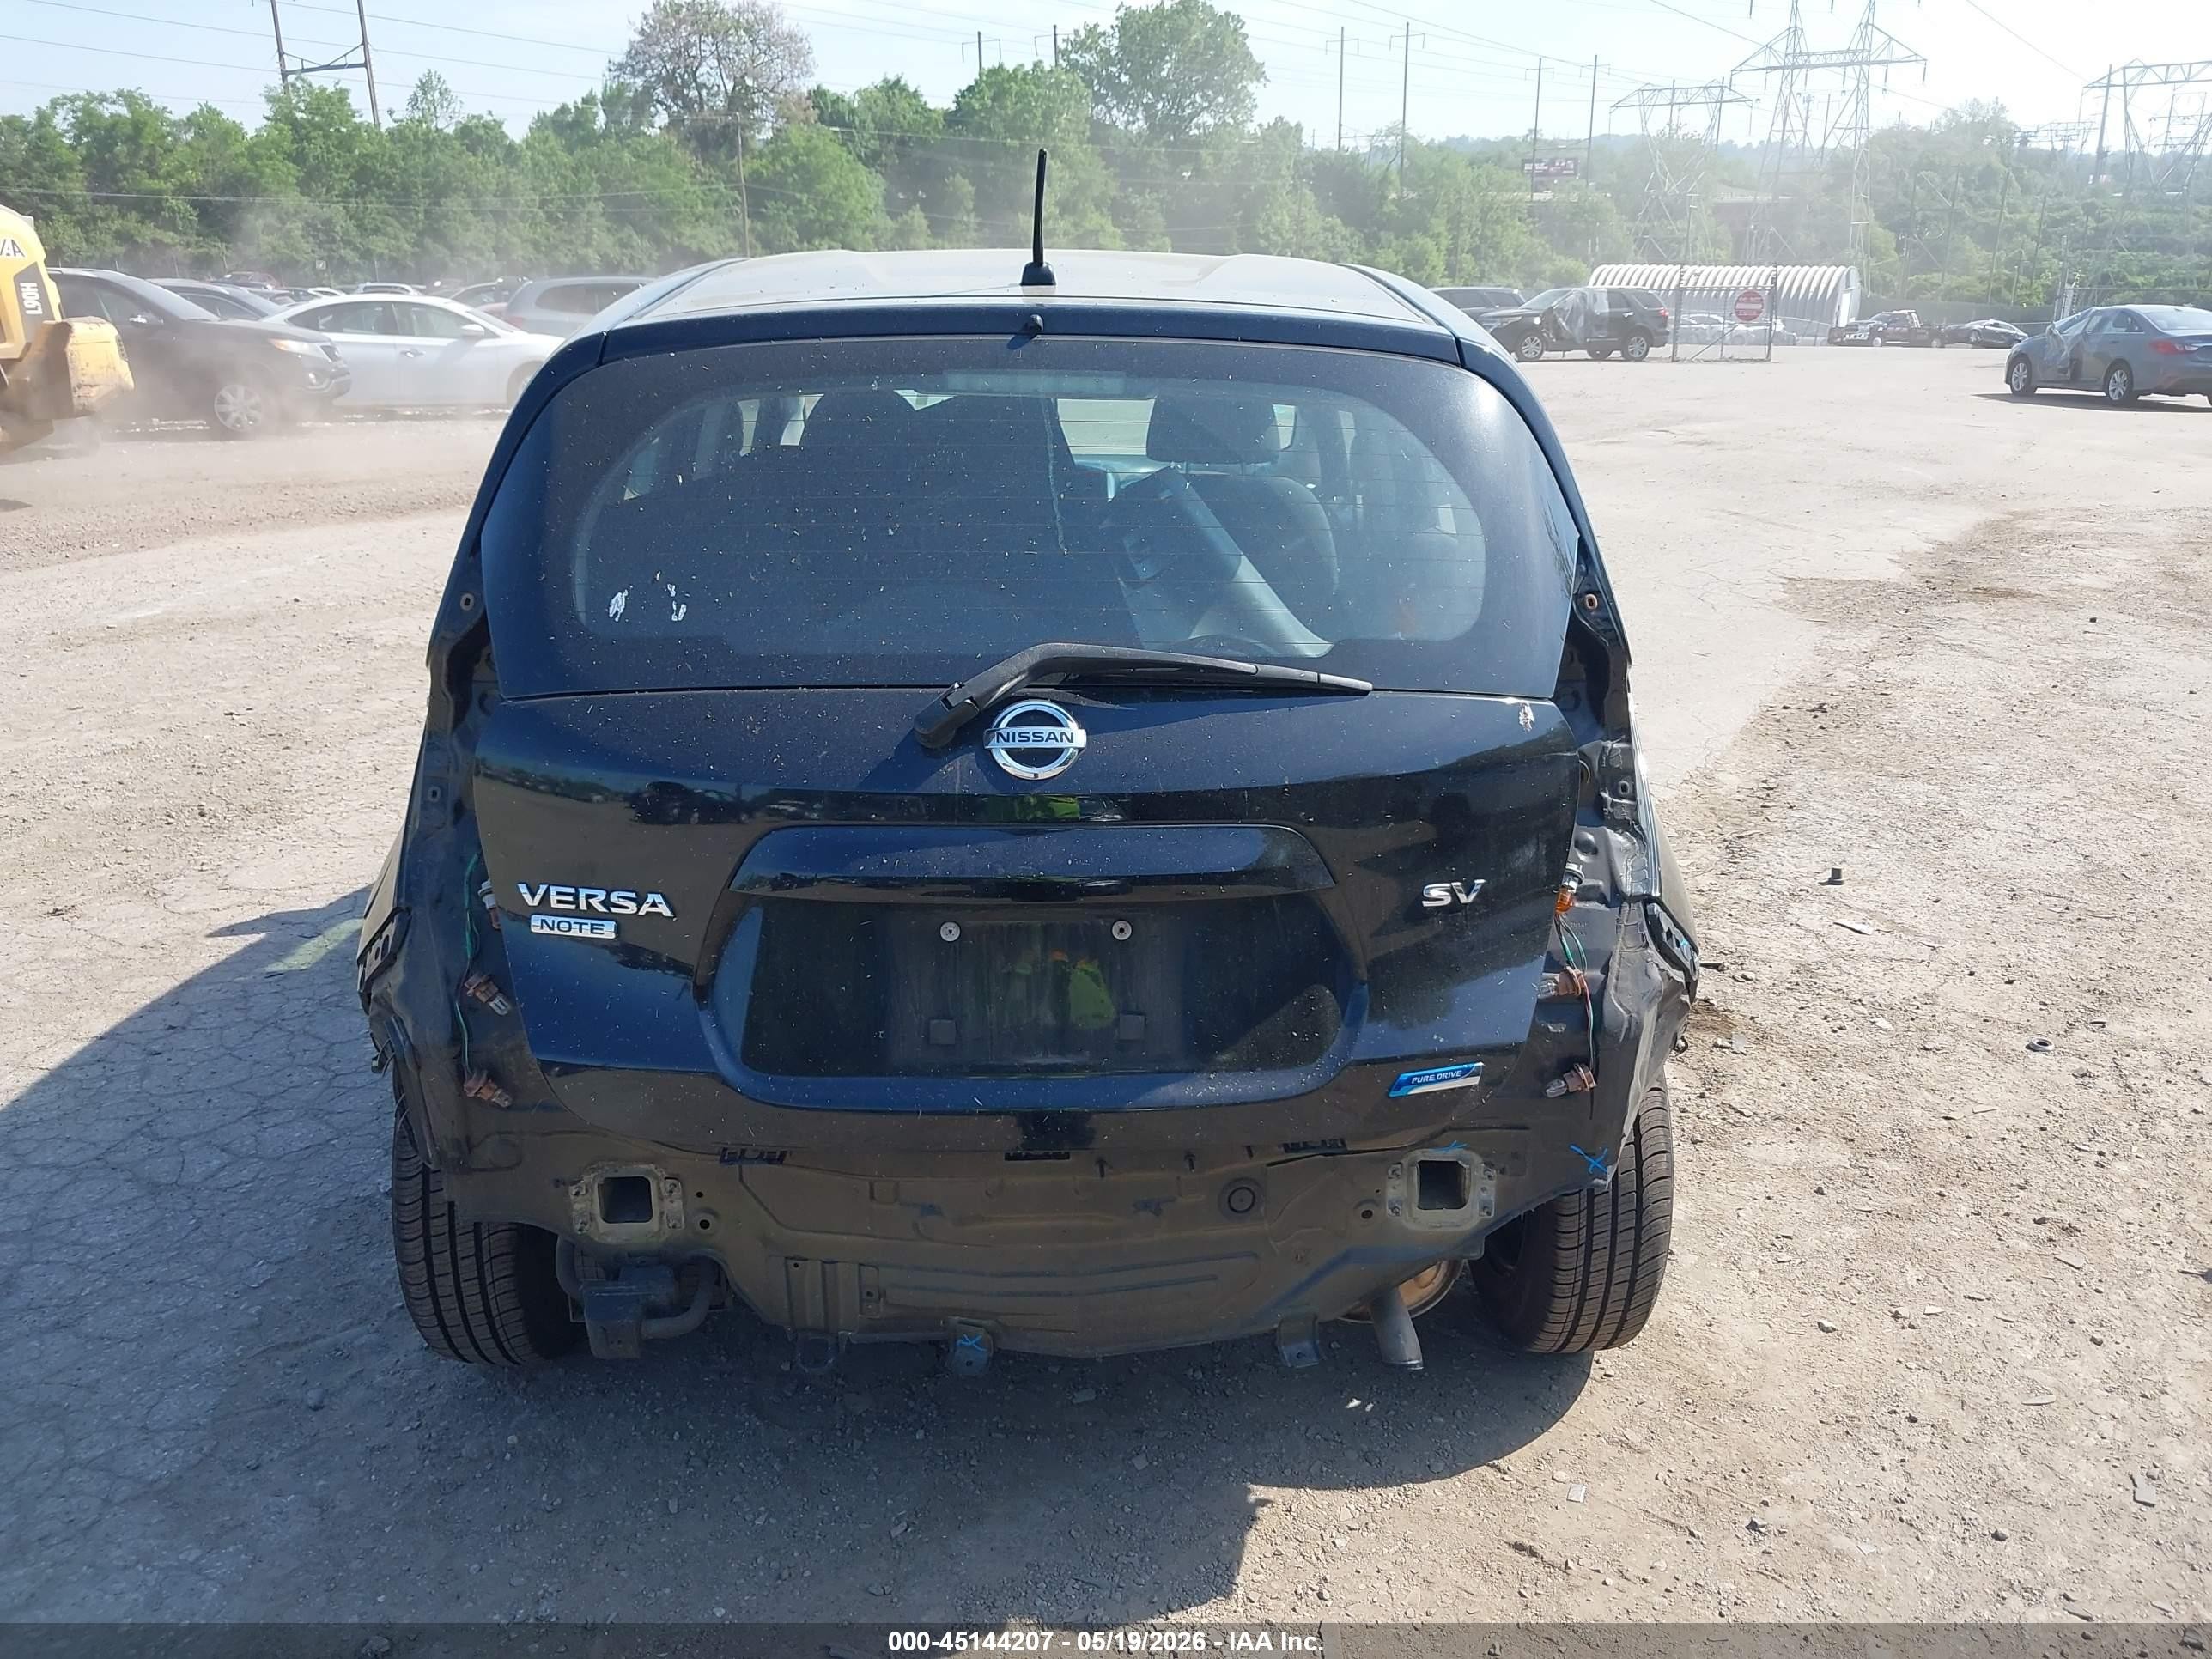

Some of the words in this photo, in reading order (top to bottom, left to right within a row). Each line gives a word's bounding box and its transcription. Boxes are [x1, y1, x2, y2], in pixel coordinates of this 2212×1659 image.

[19, 282, 43, 315] L90H
[996, 731, 1074, 744] NISSAN
[517, 883, 674, 918] VERSA
[1422, 878, 1486, 908] SV
[539, 918, 605, 935] NOTE
[1411, 1073, 1437, 1085] PURE
[1436, 1070, 1462, 1081] DRIVE
